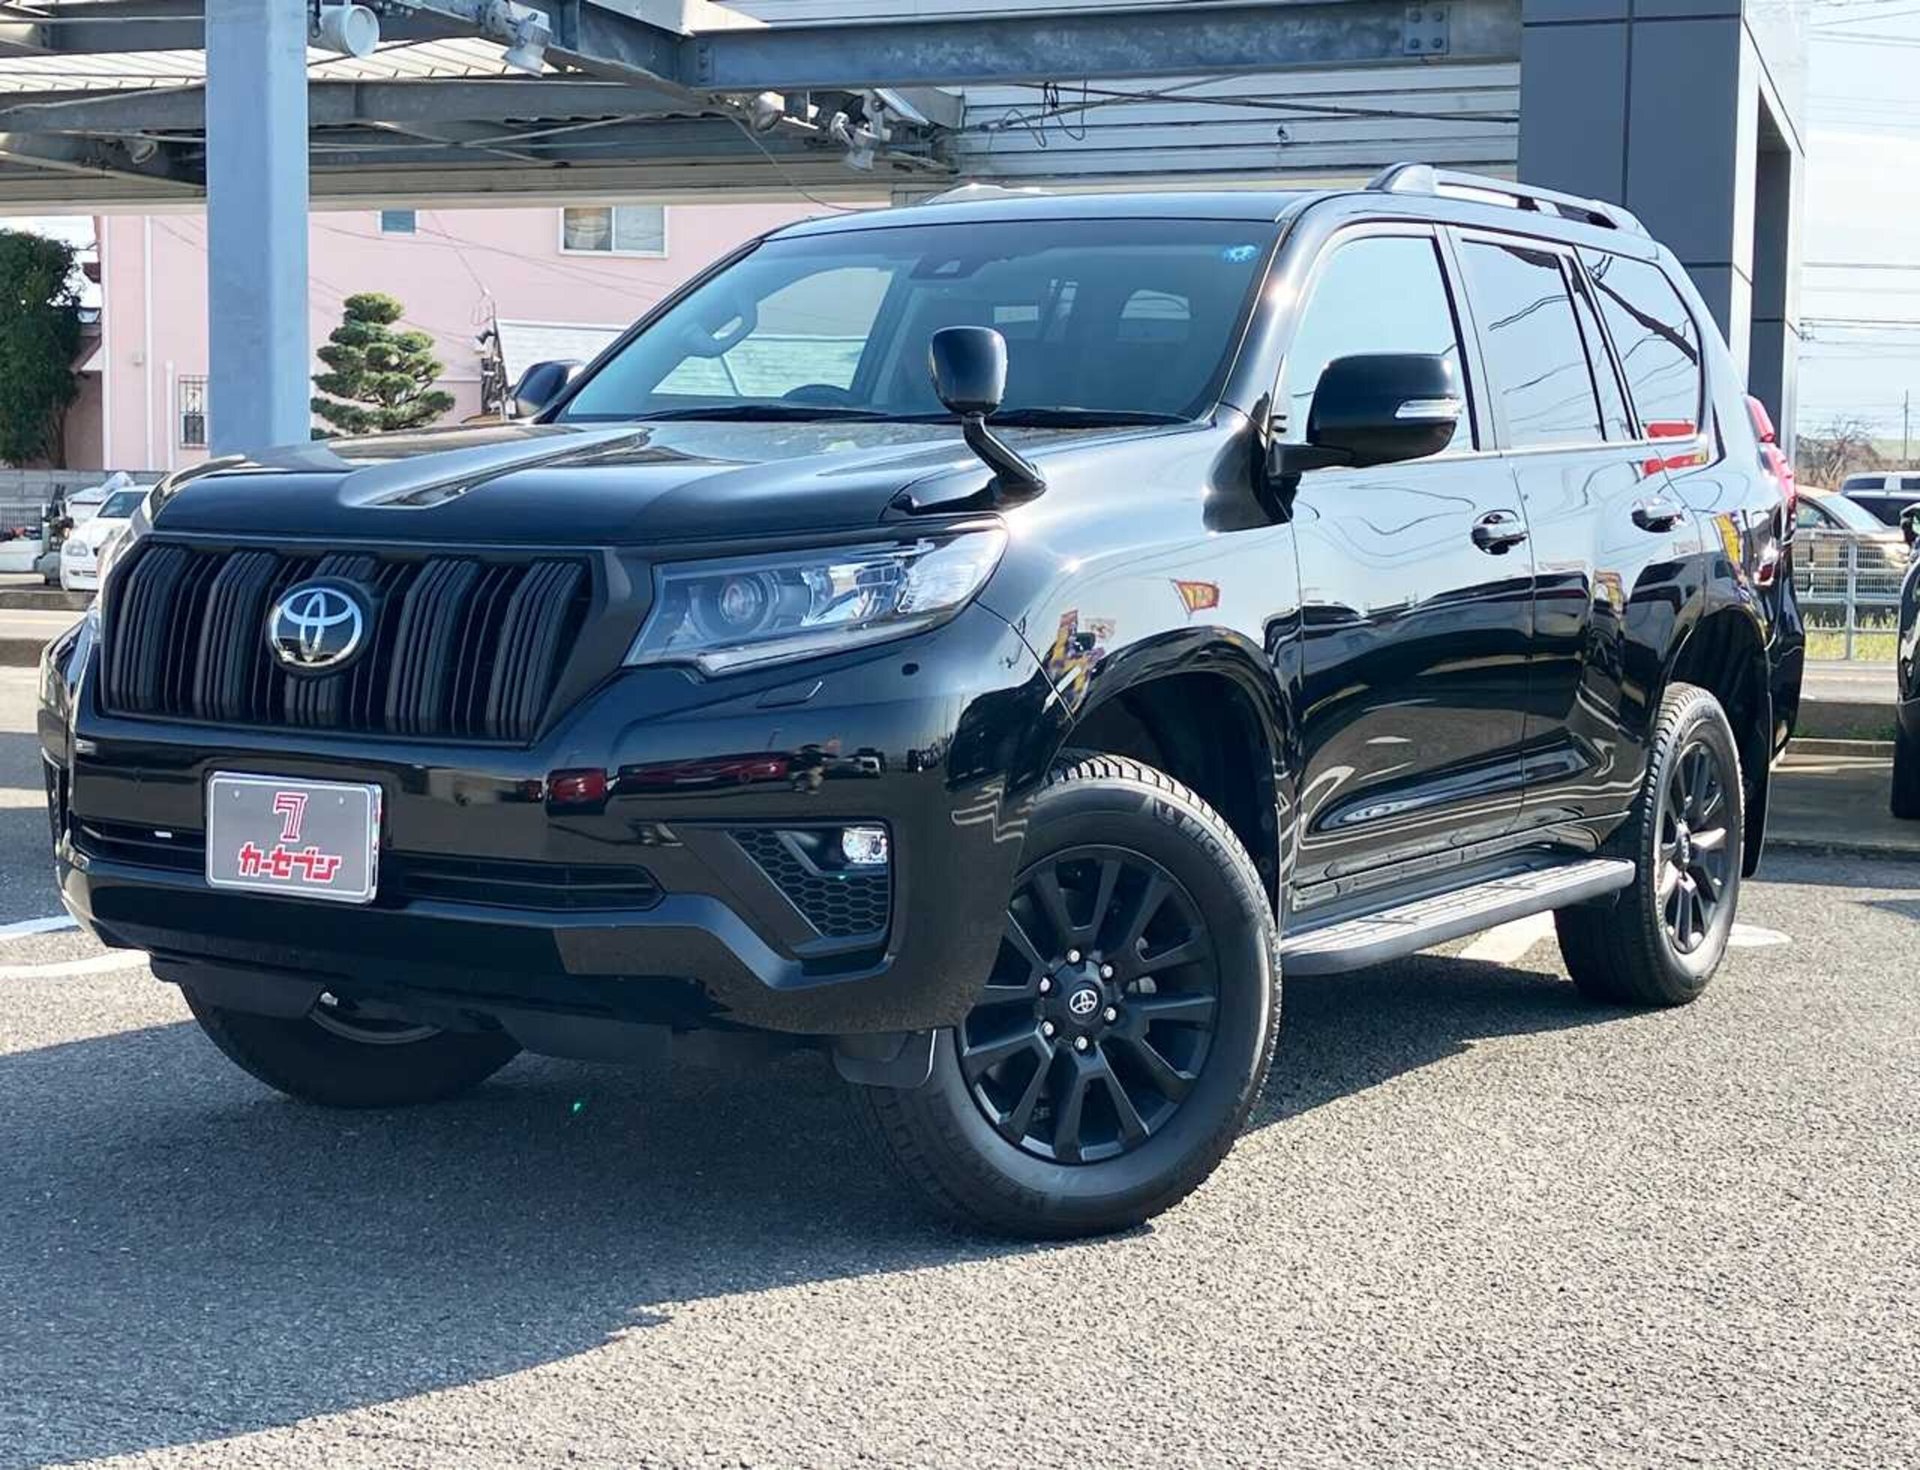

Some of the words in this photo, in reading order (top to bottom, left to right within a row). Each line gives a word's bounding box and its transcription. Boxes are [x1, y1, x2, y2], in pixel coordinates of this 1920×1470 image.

[273, 792, 308, 842] 7
[239, 842, 341, 883] カーセブン
